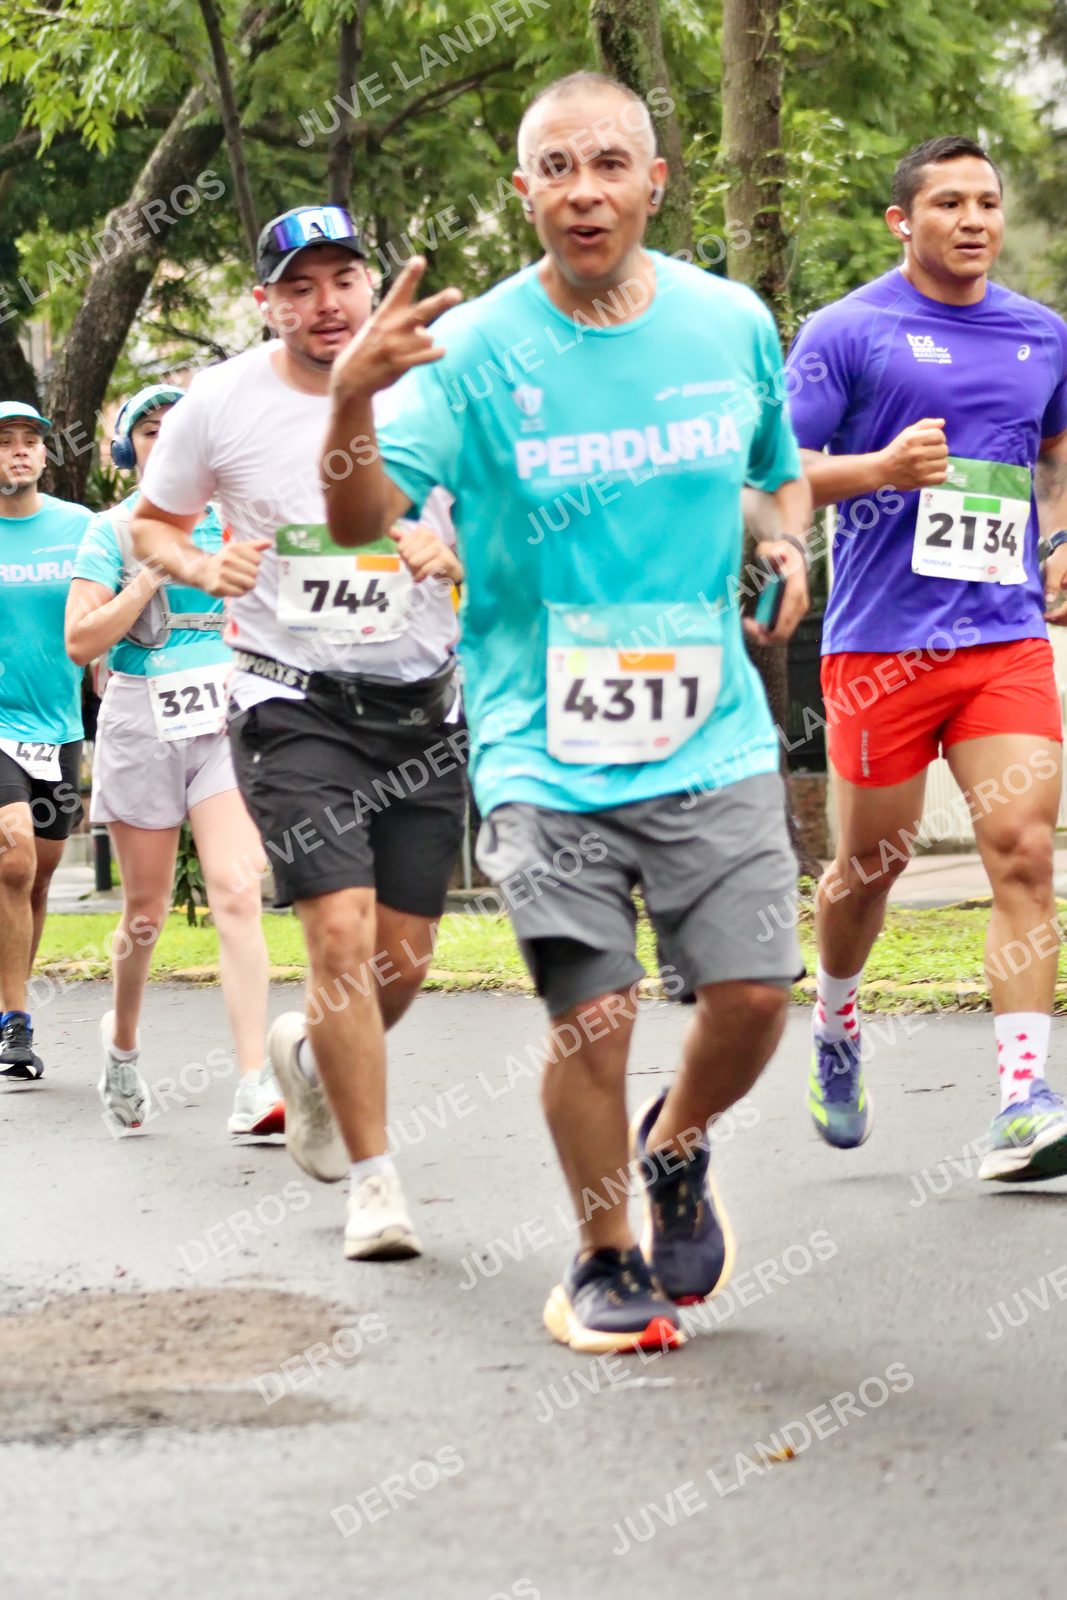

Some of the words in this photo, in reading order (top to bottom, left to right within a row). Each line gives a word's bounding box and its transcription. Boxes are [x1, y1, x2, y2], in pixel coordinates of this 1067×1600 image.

[515, 415, 742, 480] PERDURA
[925, 512, 1017, 556] 2134
[303, 578, 390, 614] 744
[158, 682, 220, 718] 321
[563, 676, 699, 722] 4311
